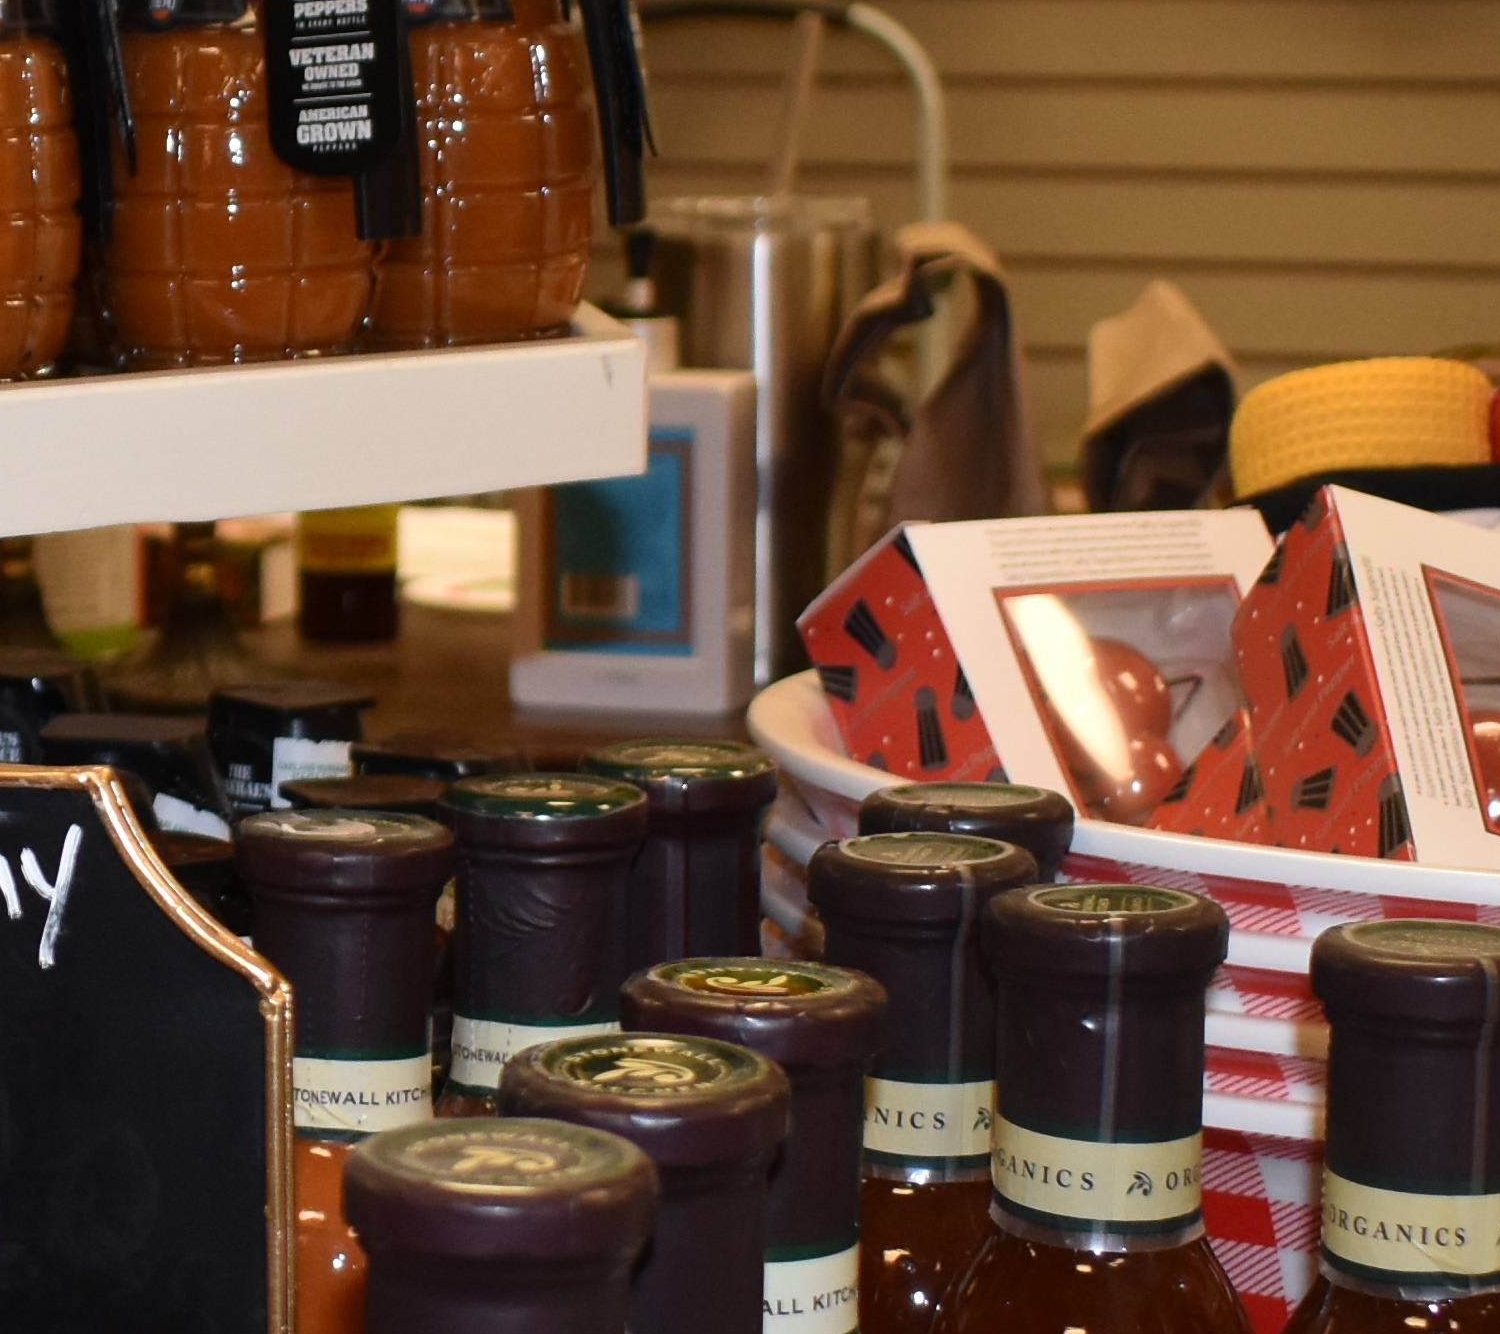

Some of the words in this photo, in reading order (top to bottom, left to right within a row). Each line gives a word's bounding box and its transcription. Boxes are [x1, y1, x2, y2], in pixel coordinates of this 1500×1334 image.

[289, 42, 375, 66] VETERAN
[303, 63, 359, 81] OWNED
[299, 104, 368, 123] AMERICAN
[297, 119, 372, 144] GROWN
[1328, 1203, 1468, 1248] ORGANICS
